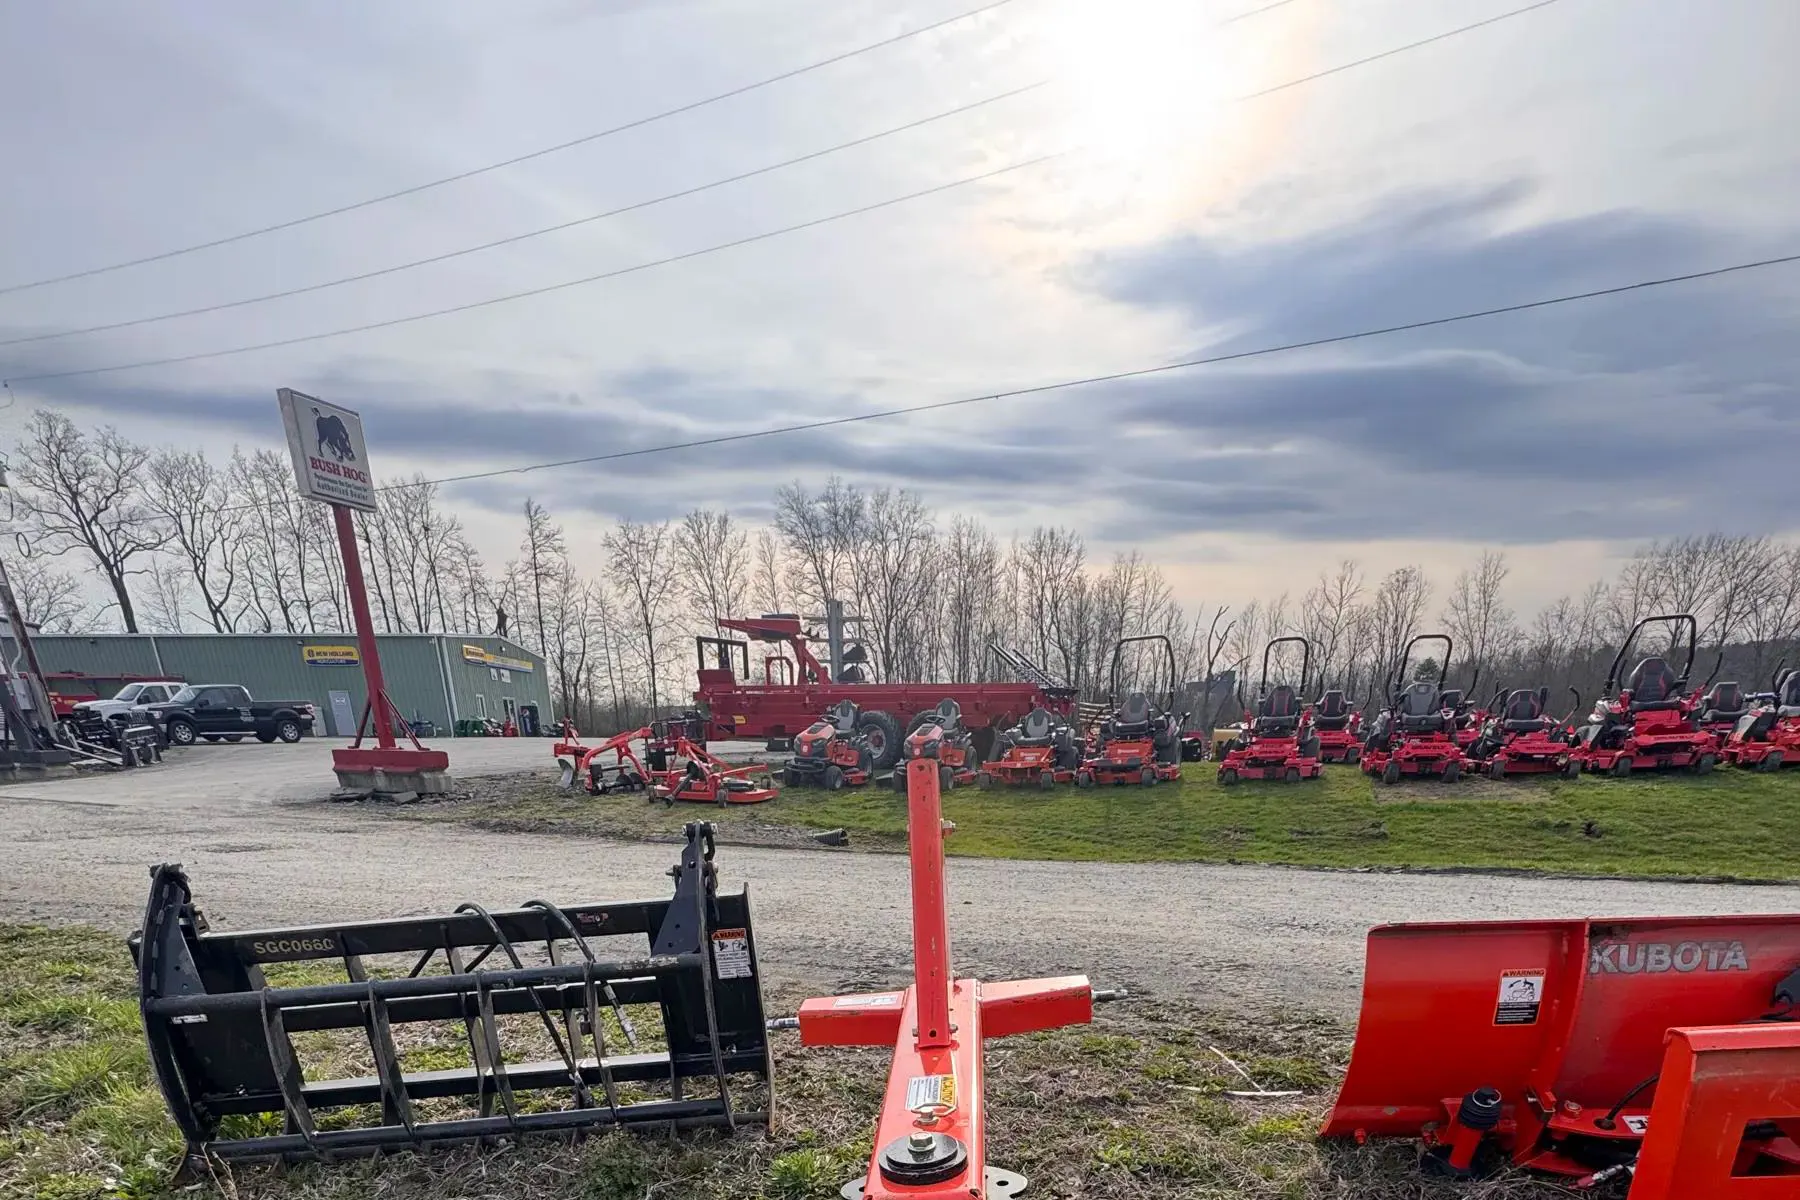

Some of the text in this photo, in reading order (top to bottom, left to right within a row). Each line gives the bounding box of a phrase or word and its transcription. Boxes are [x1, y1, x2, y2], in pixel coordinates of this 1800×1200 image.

[310, 457, 342, 477] BUSH
[343, 466, 368, 484] HOG
[1590, 941, 1748, 974] KUBOTA
